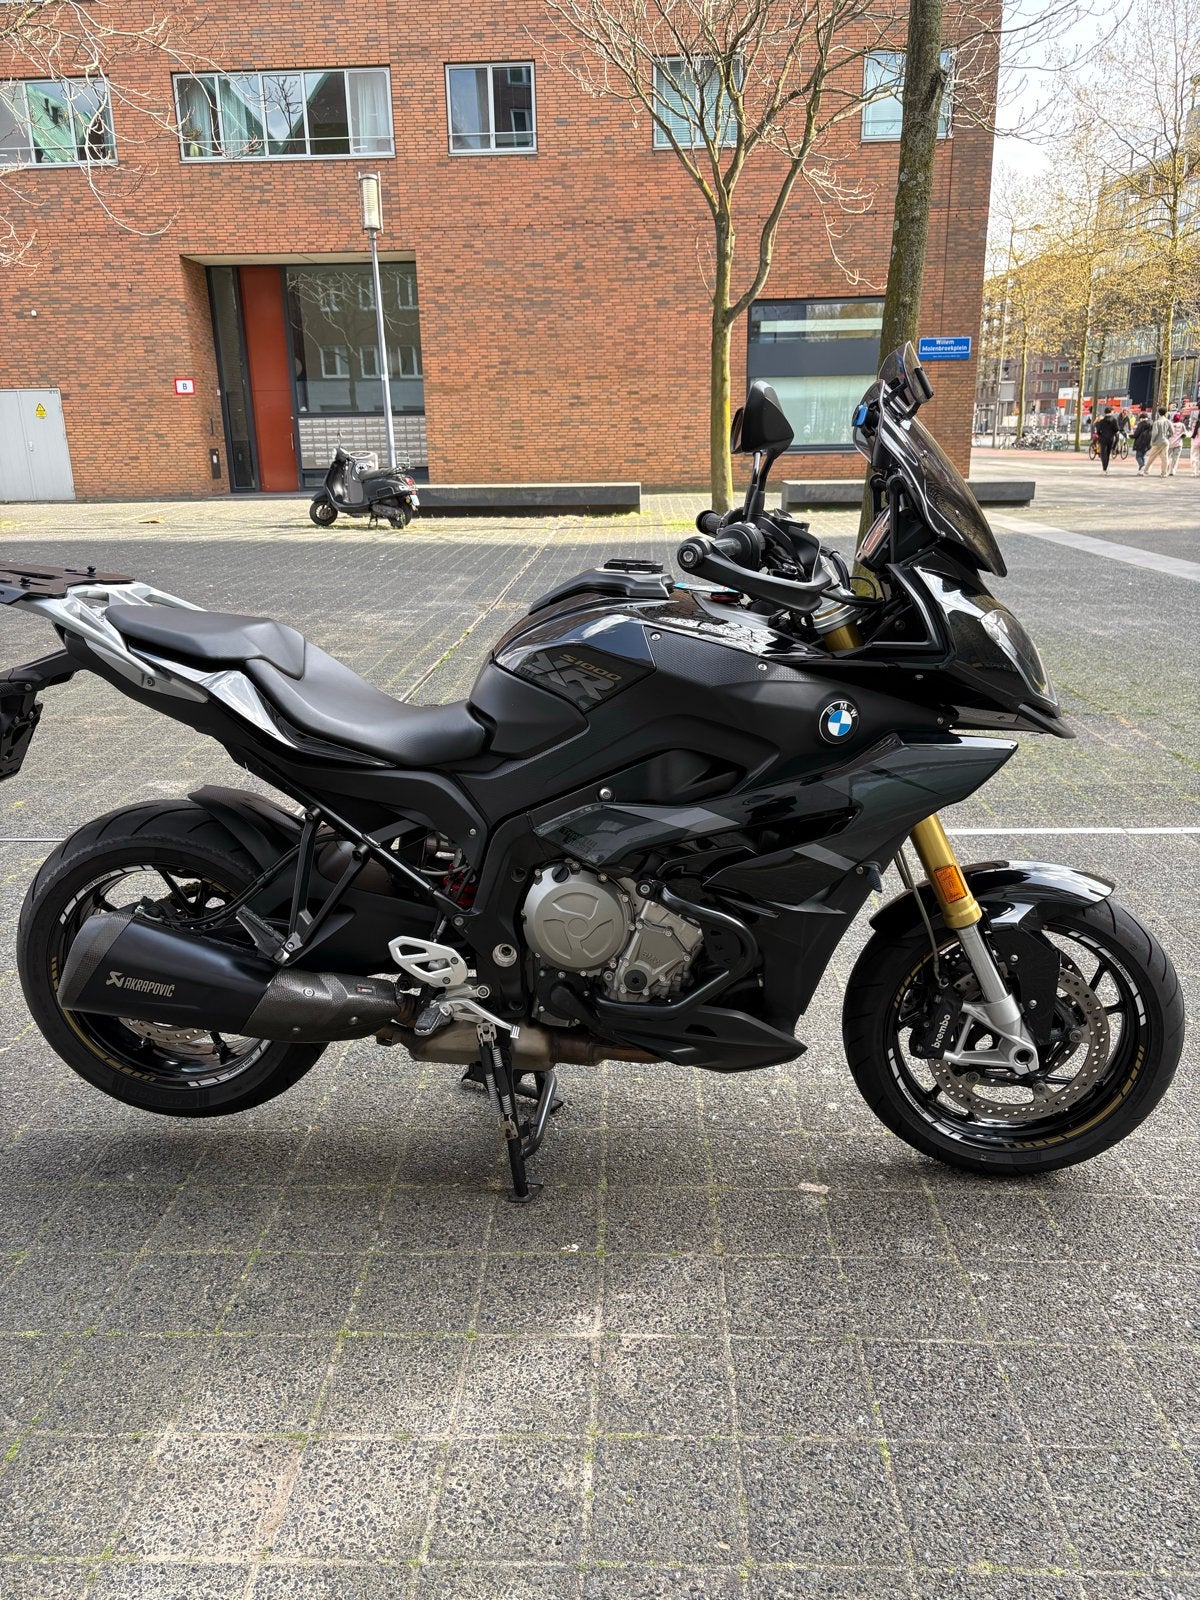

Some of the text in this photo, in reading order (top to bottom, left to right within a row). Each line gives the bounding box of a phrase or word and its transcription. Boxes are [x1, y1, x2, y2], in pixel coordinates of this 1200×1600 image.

[182, 382, 188, 391] B
[522, 651, 615, 701] XR
[559, 654, 622, 680] S1000
[826, 702, 858, 718] BMW
[931, 1014, 951, 1049] brembo
